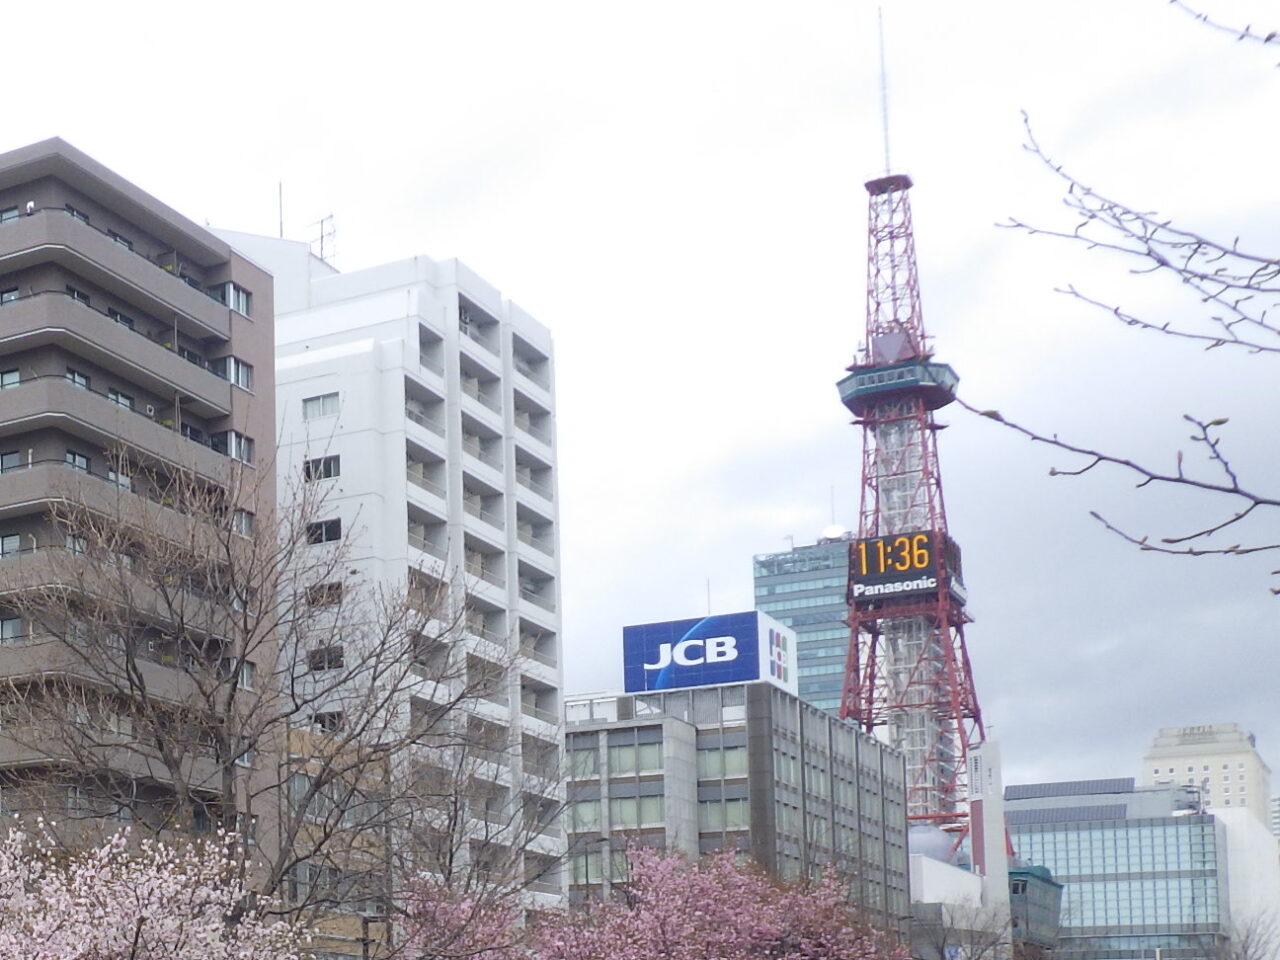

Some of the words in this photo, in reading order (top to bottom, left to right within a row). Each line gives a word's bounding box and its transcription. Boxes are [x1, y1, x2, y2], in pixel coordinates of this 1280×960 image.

[858, 534, 930, 575] 11:36
[853, 575, 937, 597] Panasonic
[643, 635, 738, 670] JCB
